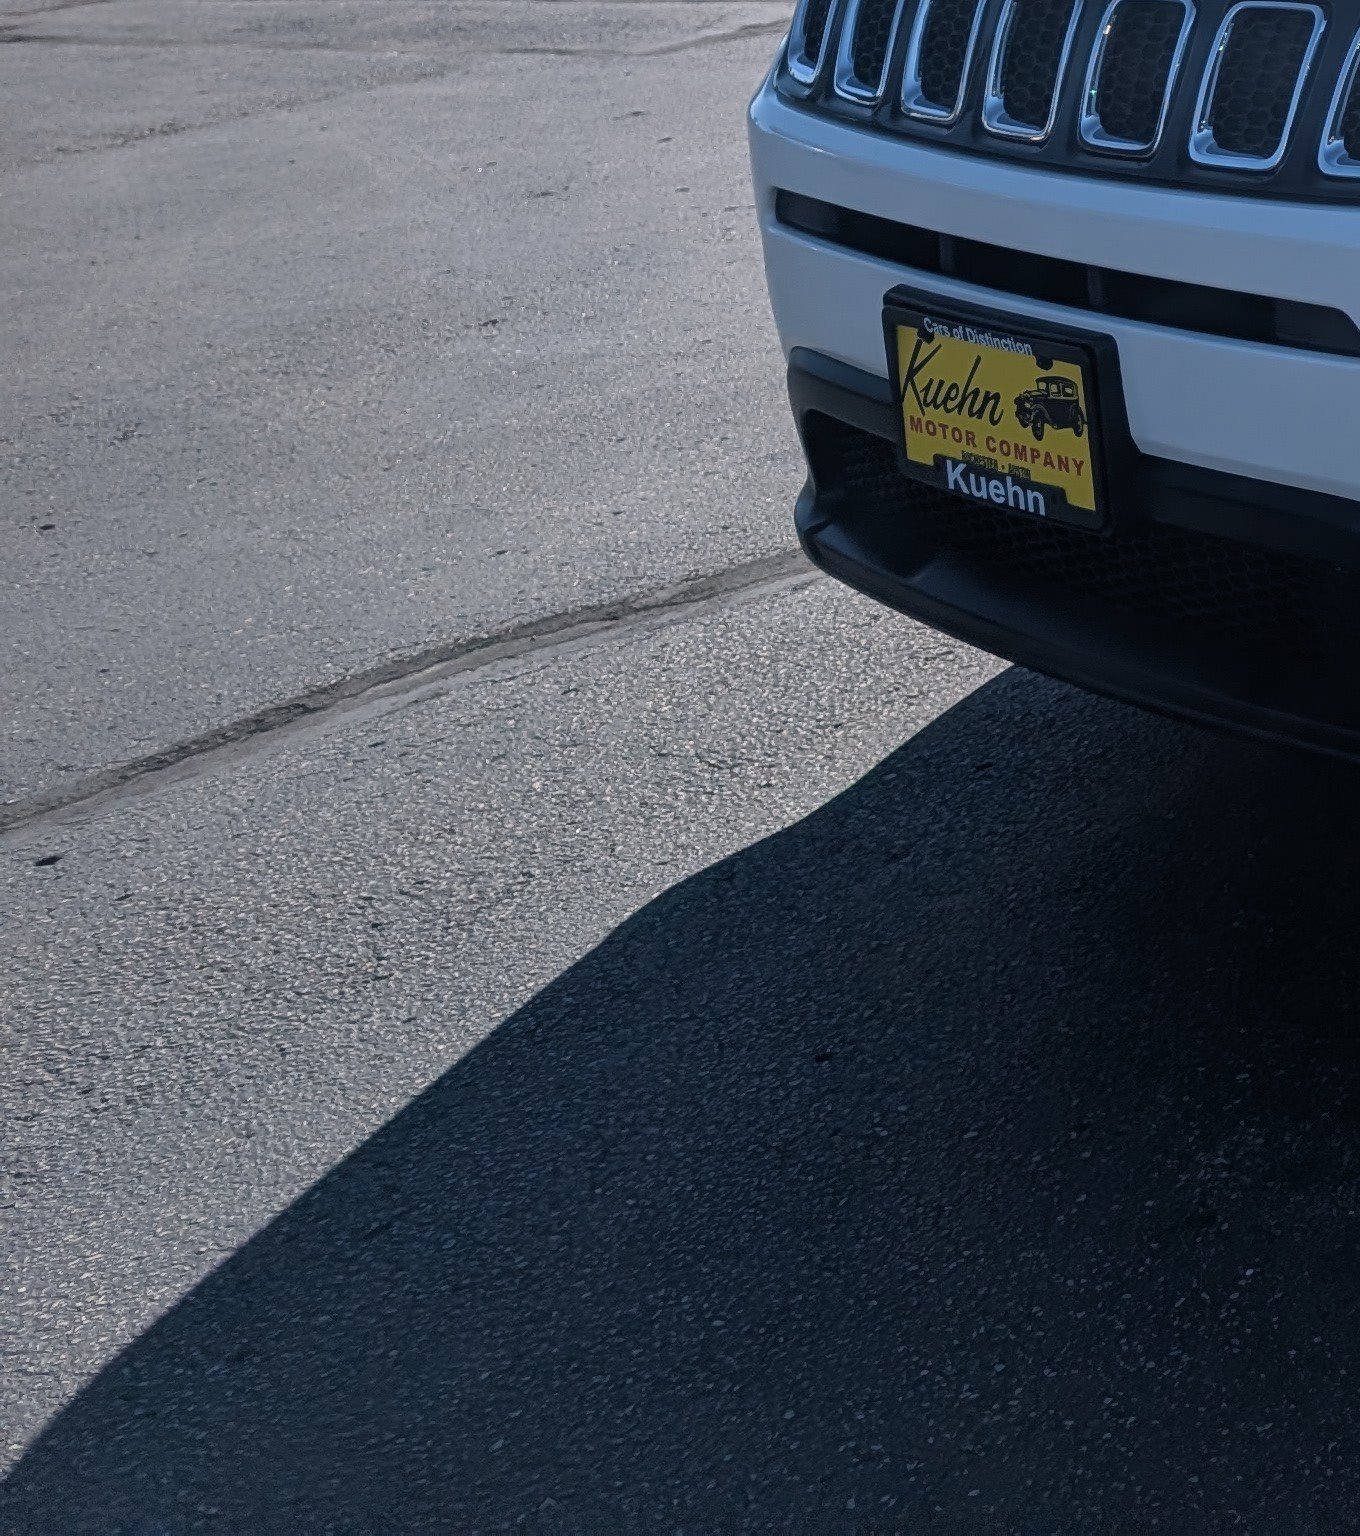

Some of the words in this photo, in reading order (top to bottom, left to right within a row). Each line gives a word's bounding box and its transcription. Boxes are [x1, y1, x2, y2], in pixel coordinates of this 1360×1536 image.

[923, 317, 950, 339] Cars
[952, 327, 964, 340] of
[964, 329, 1033, 356] Distinction
[900, 337, 1004, 427] Kuehn
[909, 415, 977, 448] MOTOR
[985, 435, 1085, 477] COMPANY
[946, 459, 1046, 516] Kuehn
